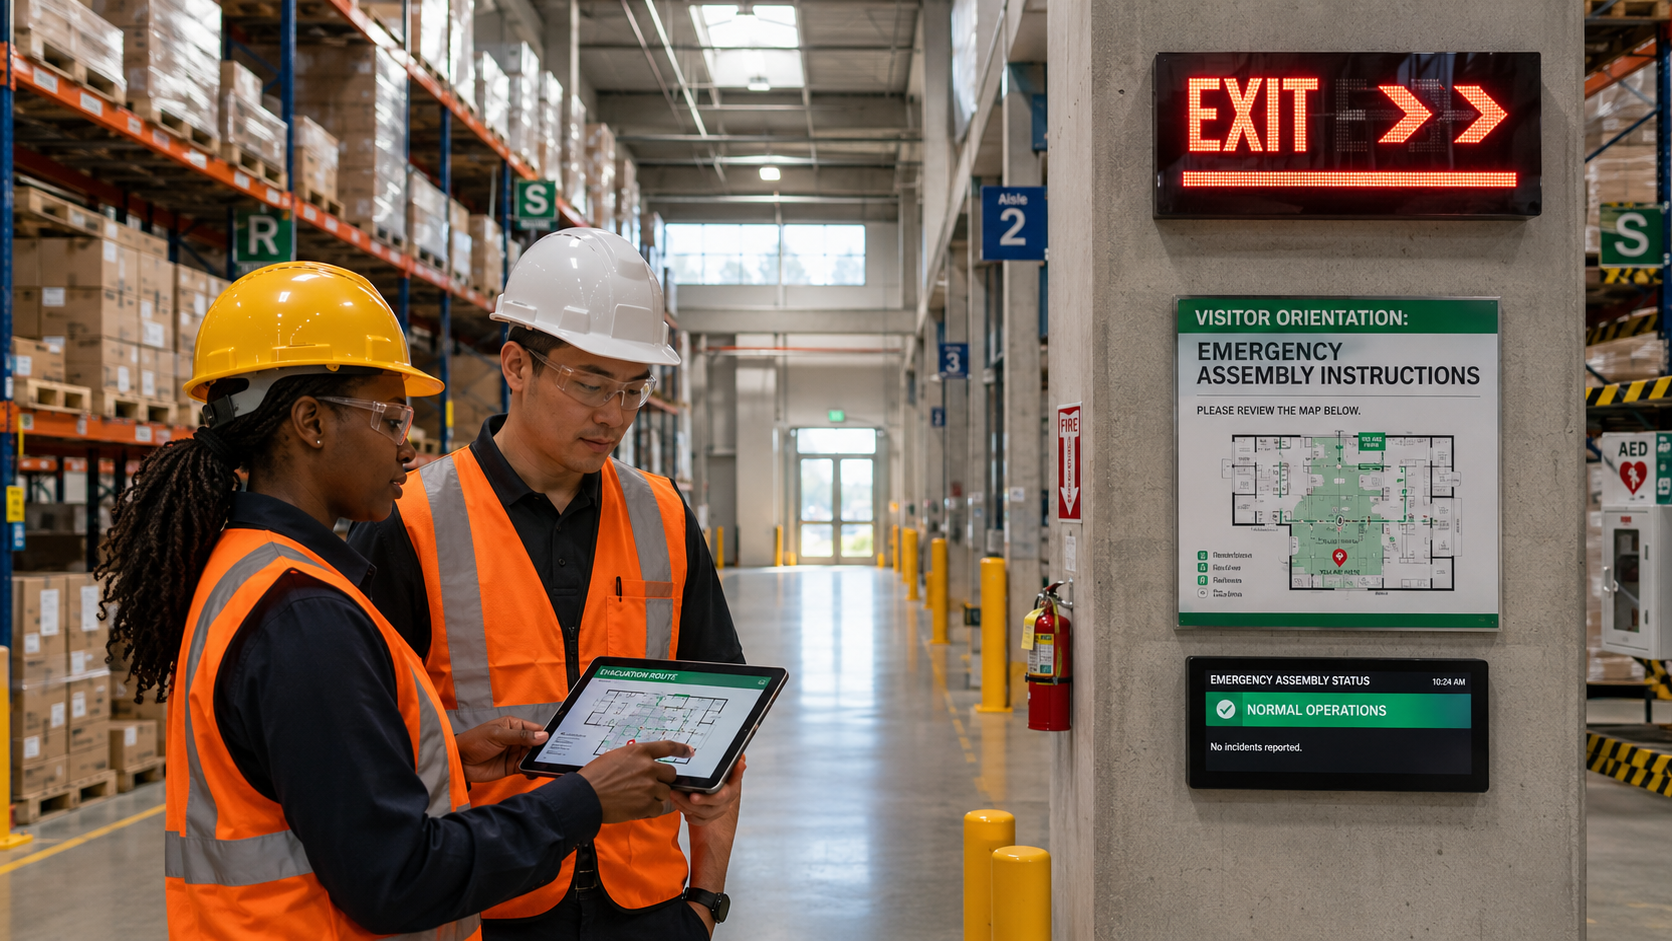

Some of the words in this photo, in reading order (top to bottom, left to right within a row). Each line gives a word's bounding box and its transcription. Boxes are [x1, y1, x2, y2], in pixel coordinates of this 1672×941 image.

[1187, 76, 1319, 153] EXIT
[524, 183, 548, 215] S
[998, 192, 1028, 206] Aisle
[248, 214, 280, 256] R
[999, 207, 1026, 246] 2
[1614, 212, 1649, 257] S
[1195, 309, 1271, 326] VISITOR
[1276, 310, 1409, 326] ORIENTATION:
[1197, 341, 1343, 361] EMERGENCY
[945, 351, 961, 373] 3
[1196, 365, 1315, 385] ASSEMBLY
[1320, 365, 1480, 385] INSTRUCTIONS
[1197, 405, 1235, 416] PLEASE
[1237, 405, 1275, 416] REVIEW
[1277, 405, 1297, 416] THE
[1299, 405, 1322, 416] MAP
[1324, 405, 1361, 416] BELOW.
[1060, 416, 1078, 433] FIRE
[1618, 441, 1648, 457] AED
[1210, 674, 1273, 685] EMERGENCY
[1275, 675, 1330, 686] ASSEMBLY
[1332, 675, 1371, 686] STATUS
[1432, 677, 1452, 687] 10:24
[1453, 677, 1466, 687] AM
[1247, 703, 1303, 717] NORMAL
[1306, 703, 1387, 718] OPERATIONS
[1210, 742, 1222, 752] No
[1224, 742, 1263, 752] incidents
[1265, 742, 1303, 755] reported.
